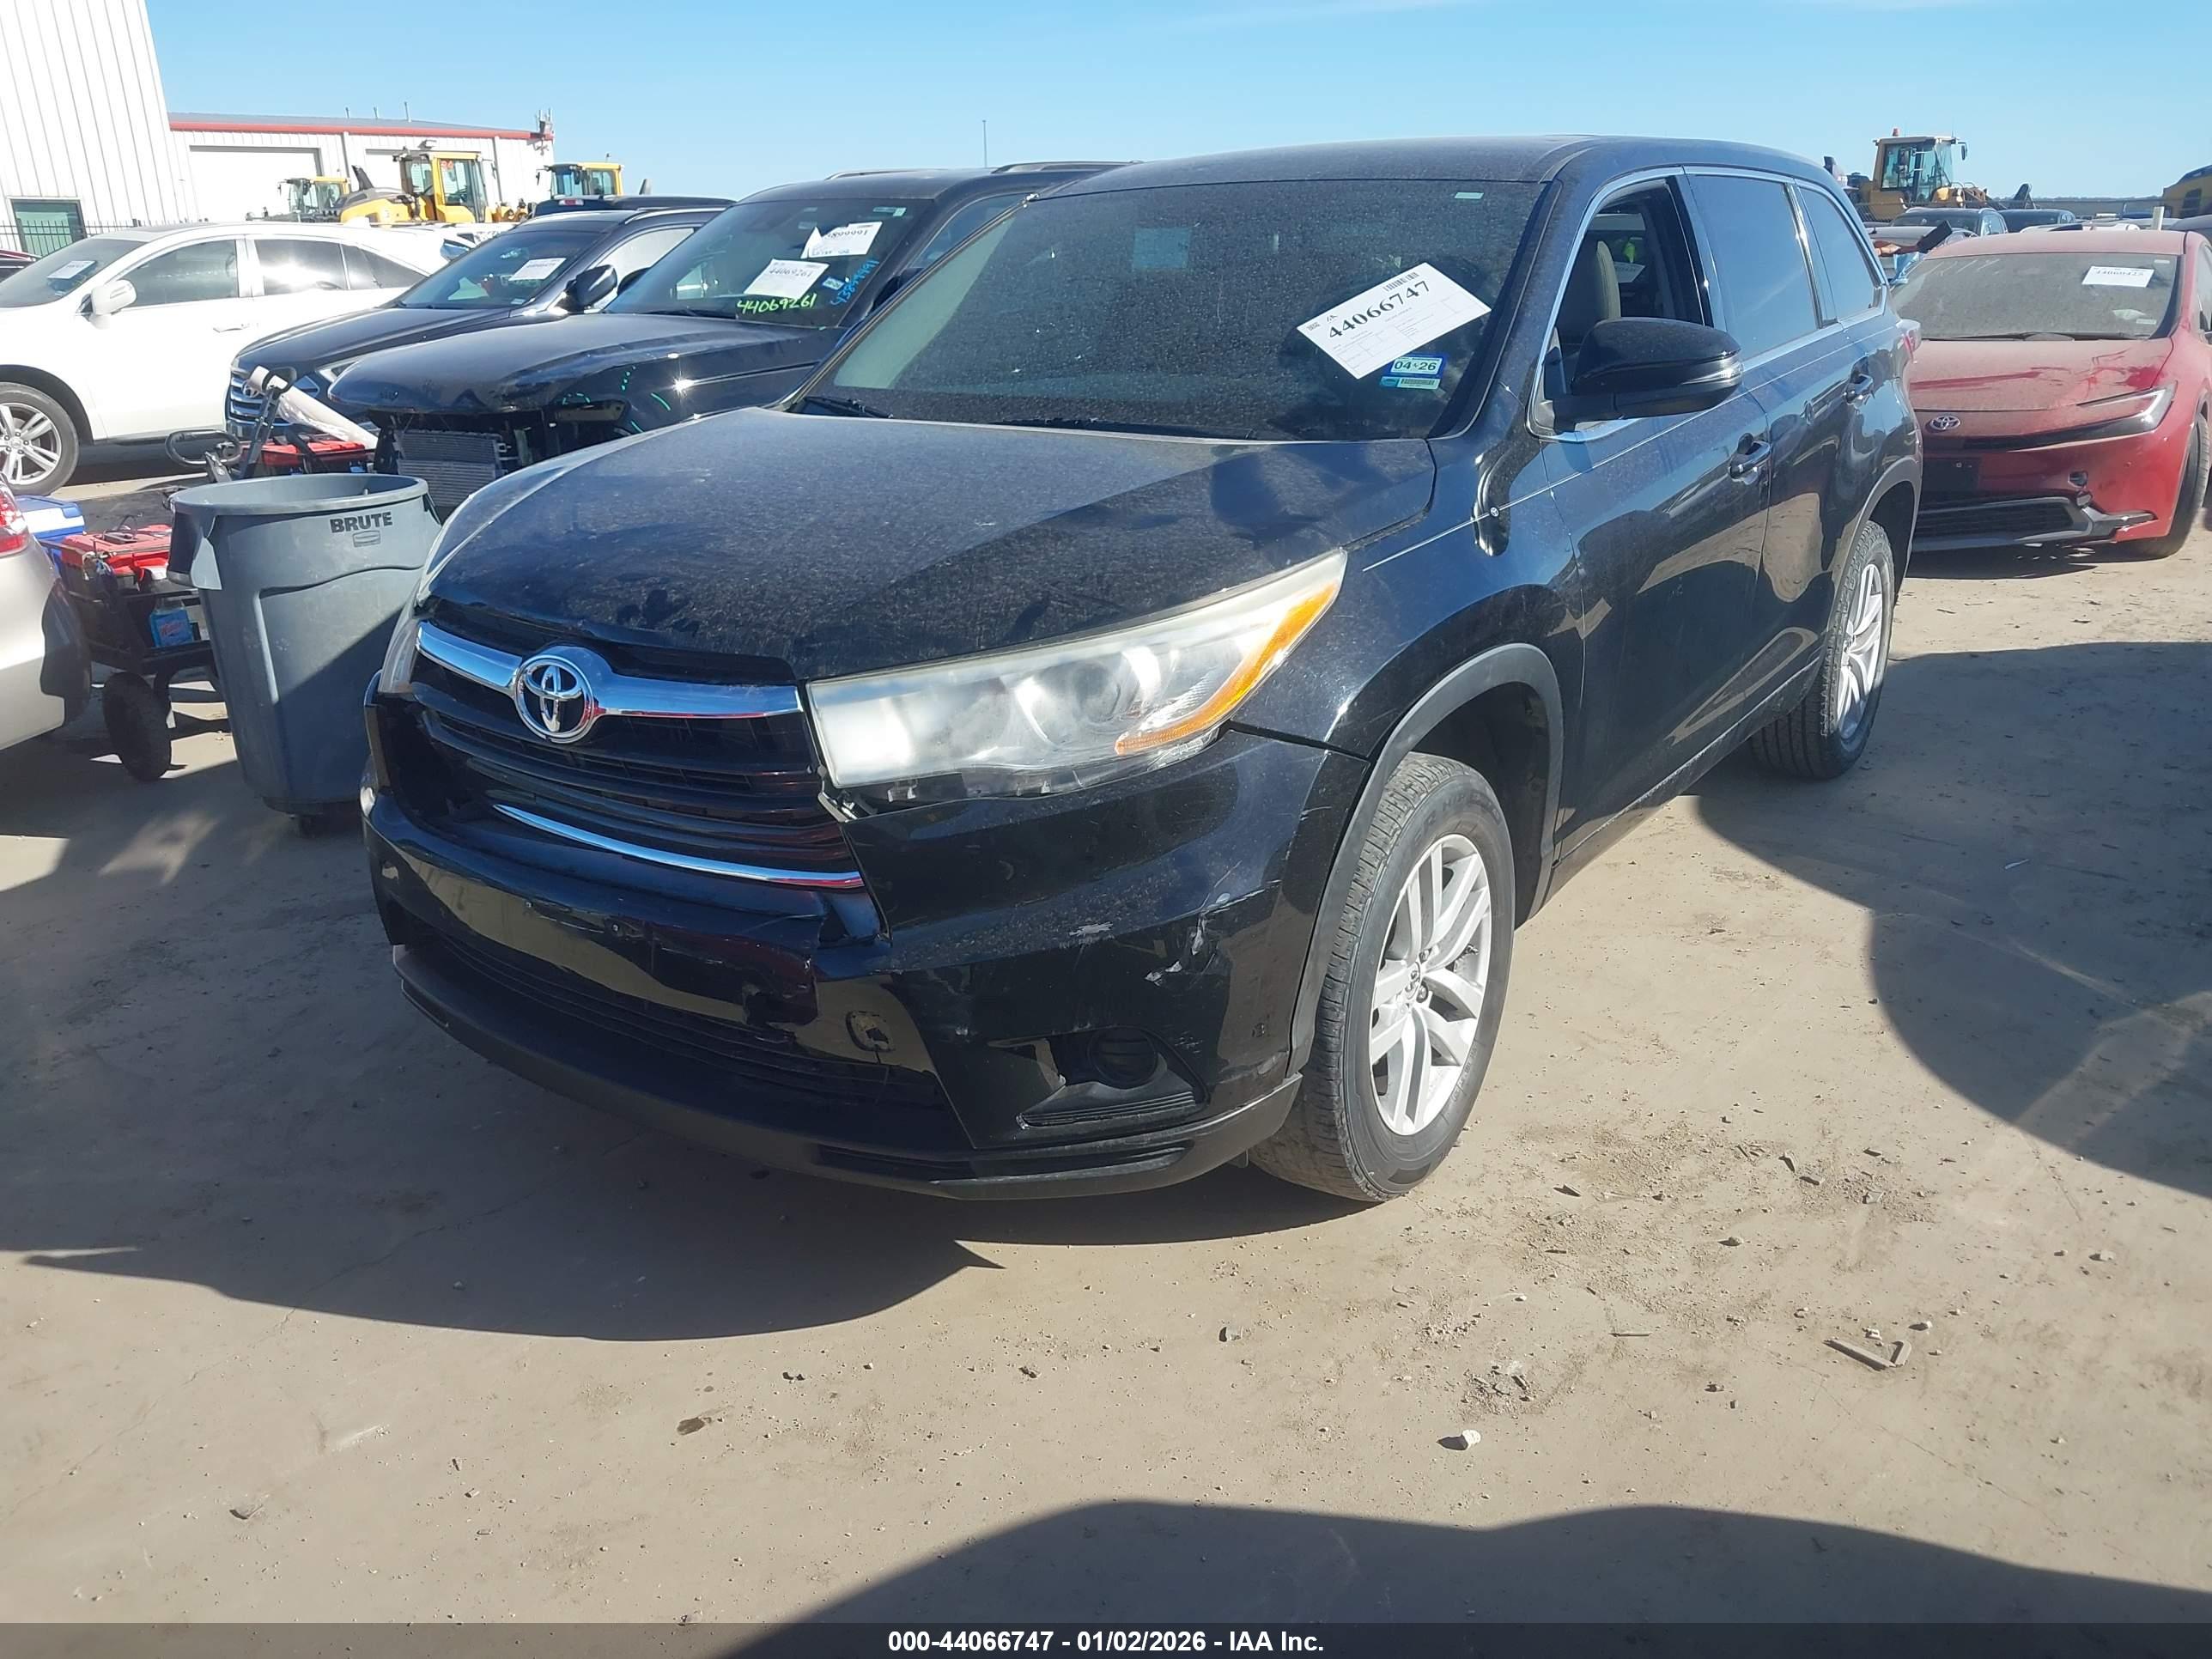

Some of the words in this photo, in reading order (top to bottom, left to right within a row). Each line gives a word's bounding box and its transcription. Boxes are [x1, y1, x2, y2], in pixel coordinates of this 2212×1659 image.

[737, 294, 817, 315] 44069261
[1329, 280, 1431, 339] 44066747
[1394, 361, 1412, 370] 04
[1418, 362, 1437, 371] 26
[330, 512, 393, 533] BRUTE
